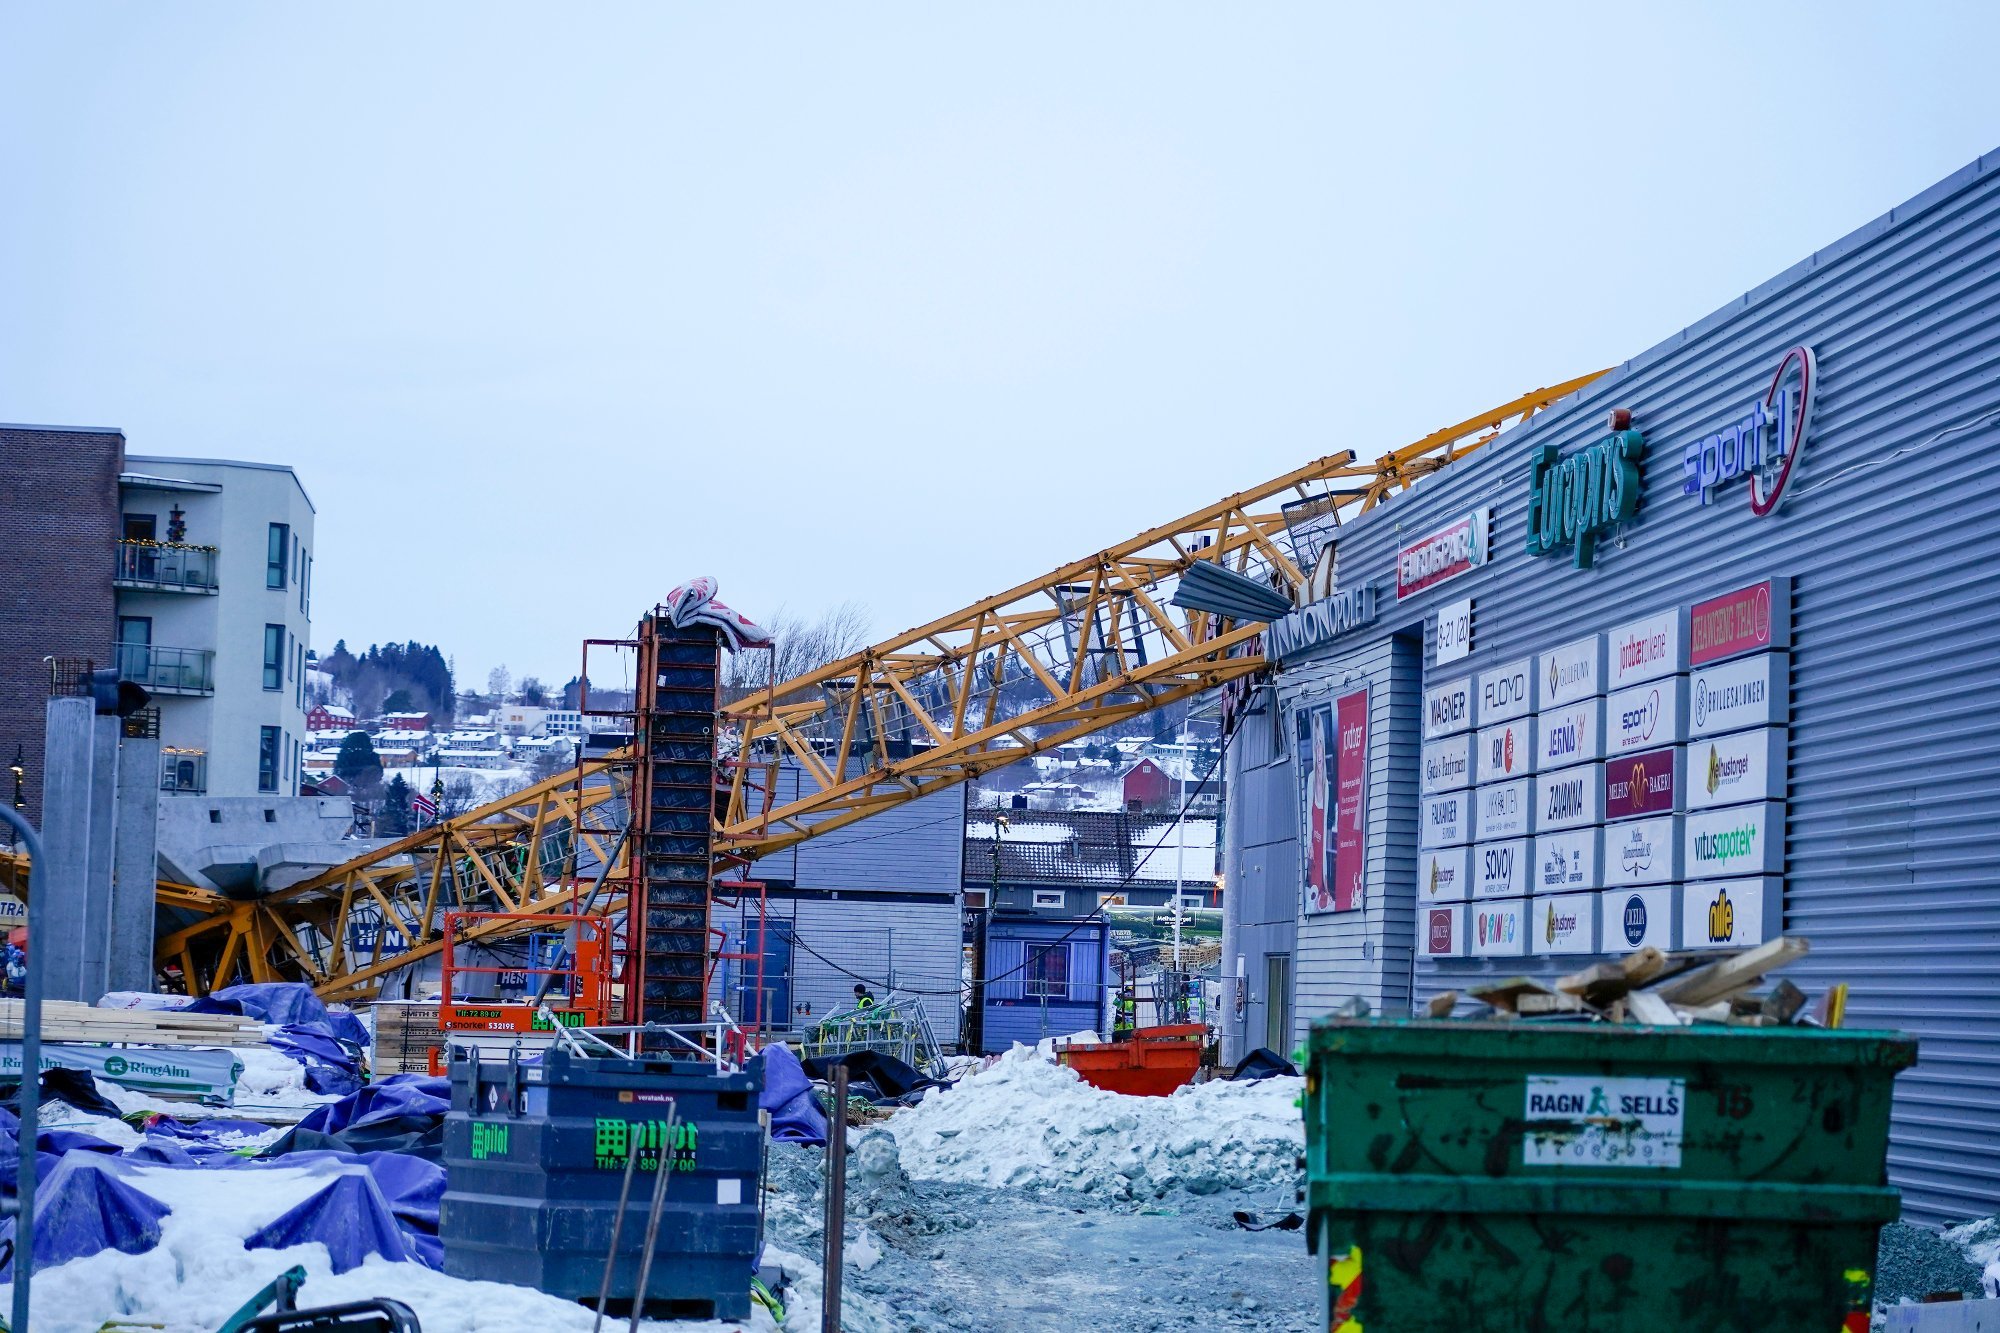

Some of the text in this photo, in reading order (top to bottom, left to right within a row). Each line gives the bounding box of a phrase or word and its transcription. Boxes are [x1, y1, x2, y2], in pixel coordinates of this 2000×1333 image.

[1684, 400, 1774, 505] sport
[1525, 408, 1643, 569] Europris
[1485, 673, 1524, 710] FLOYD
[1708, 678, 1765, 713] BRILLESALONGEN
[1430, 691, 1466, 728] WAGNER
[1622, 706, 1647, 734] sport
[1711, 753, 1749, 779] Melhustorget
[1650, 773, 1672, 794] BAKERI
[1709, 888, 1733, 943] nille
[501, 972, 529, 985] HEN
[130, 1062, 190, 1078] RingAlm
[1530, 1094, 1679, 1116] RAGN SELLS
[484, 1126, 508, 1160] pilot
[641, 1158, 657, 1170] 89
